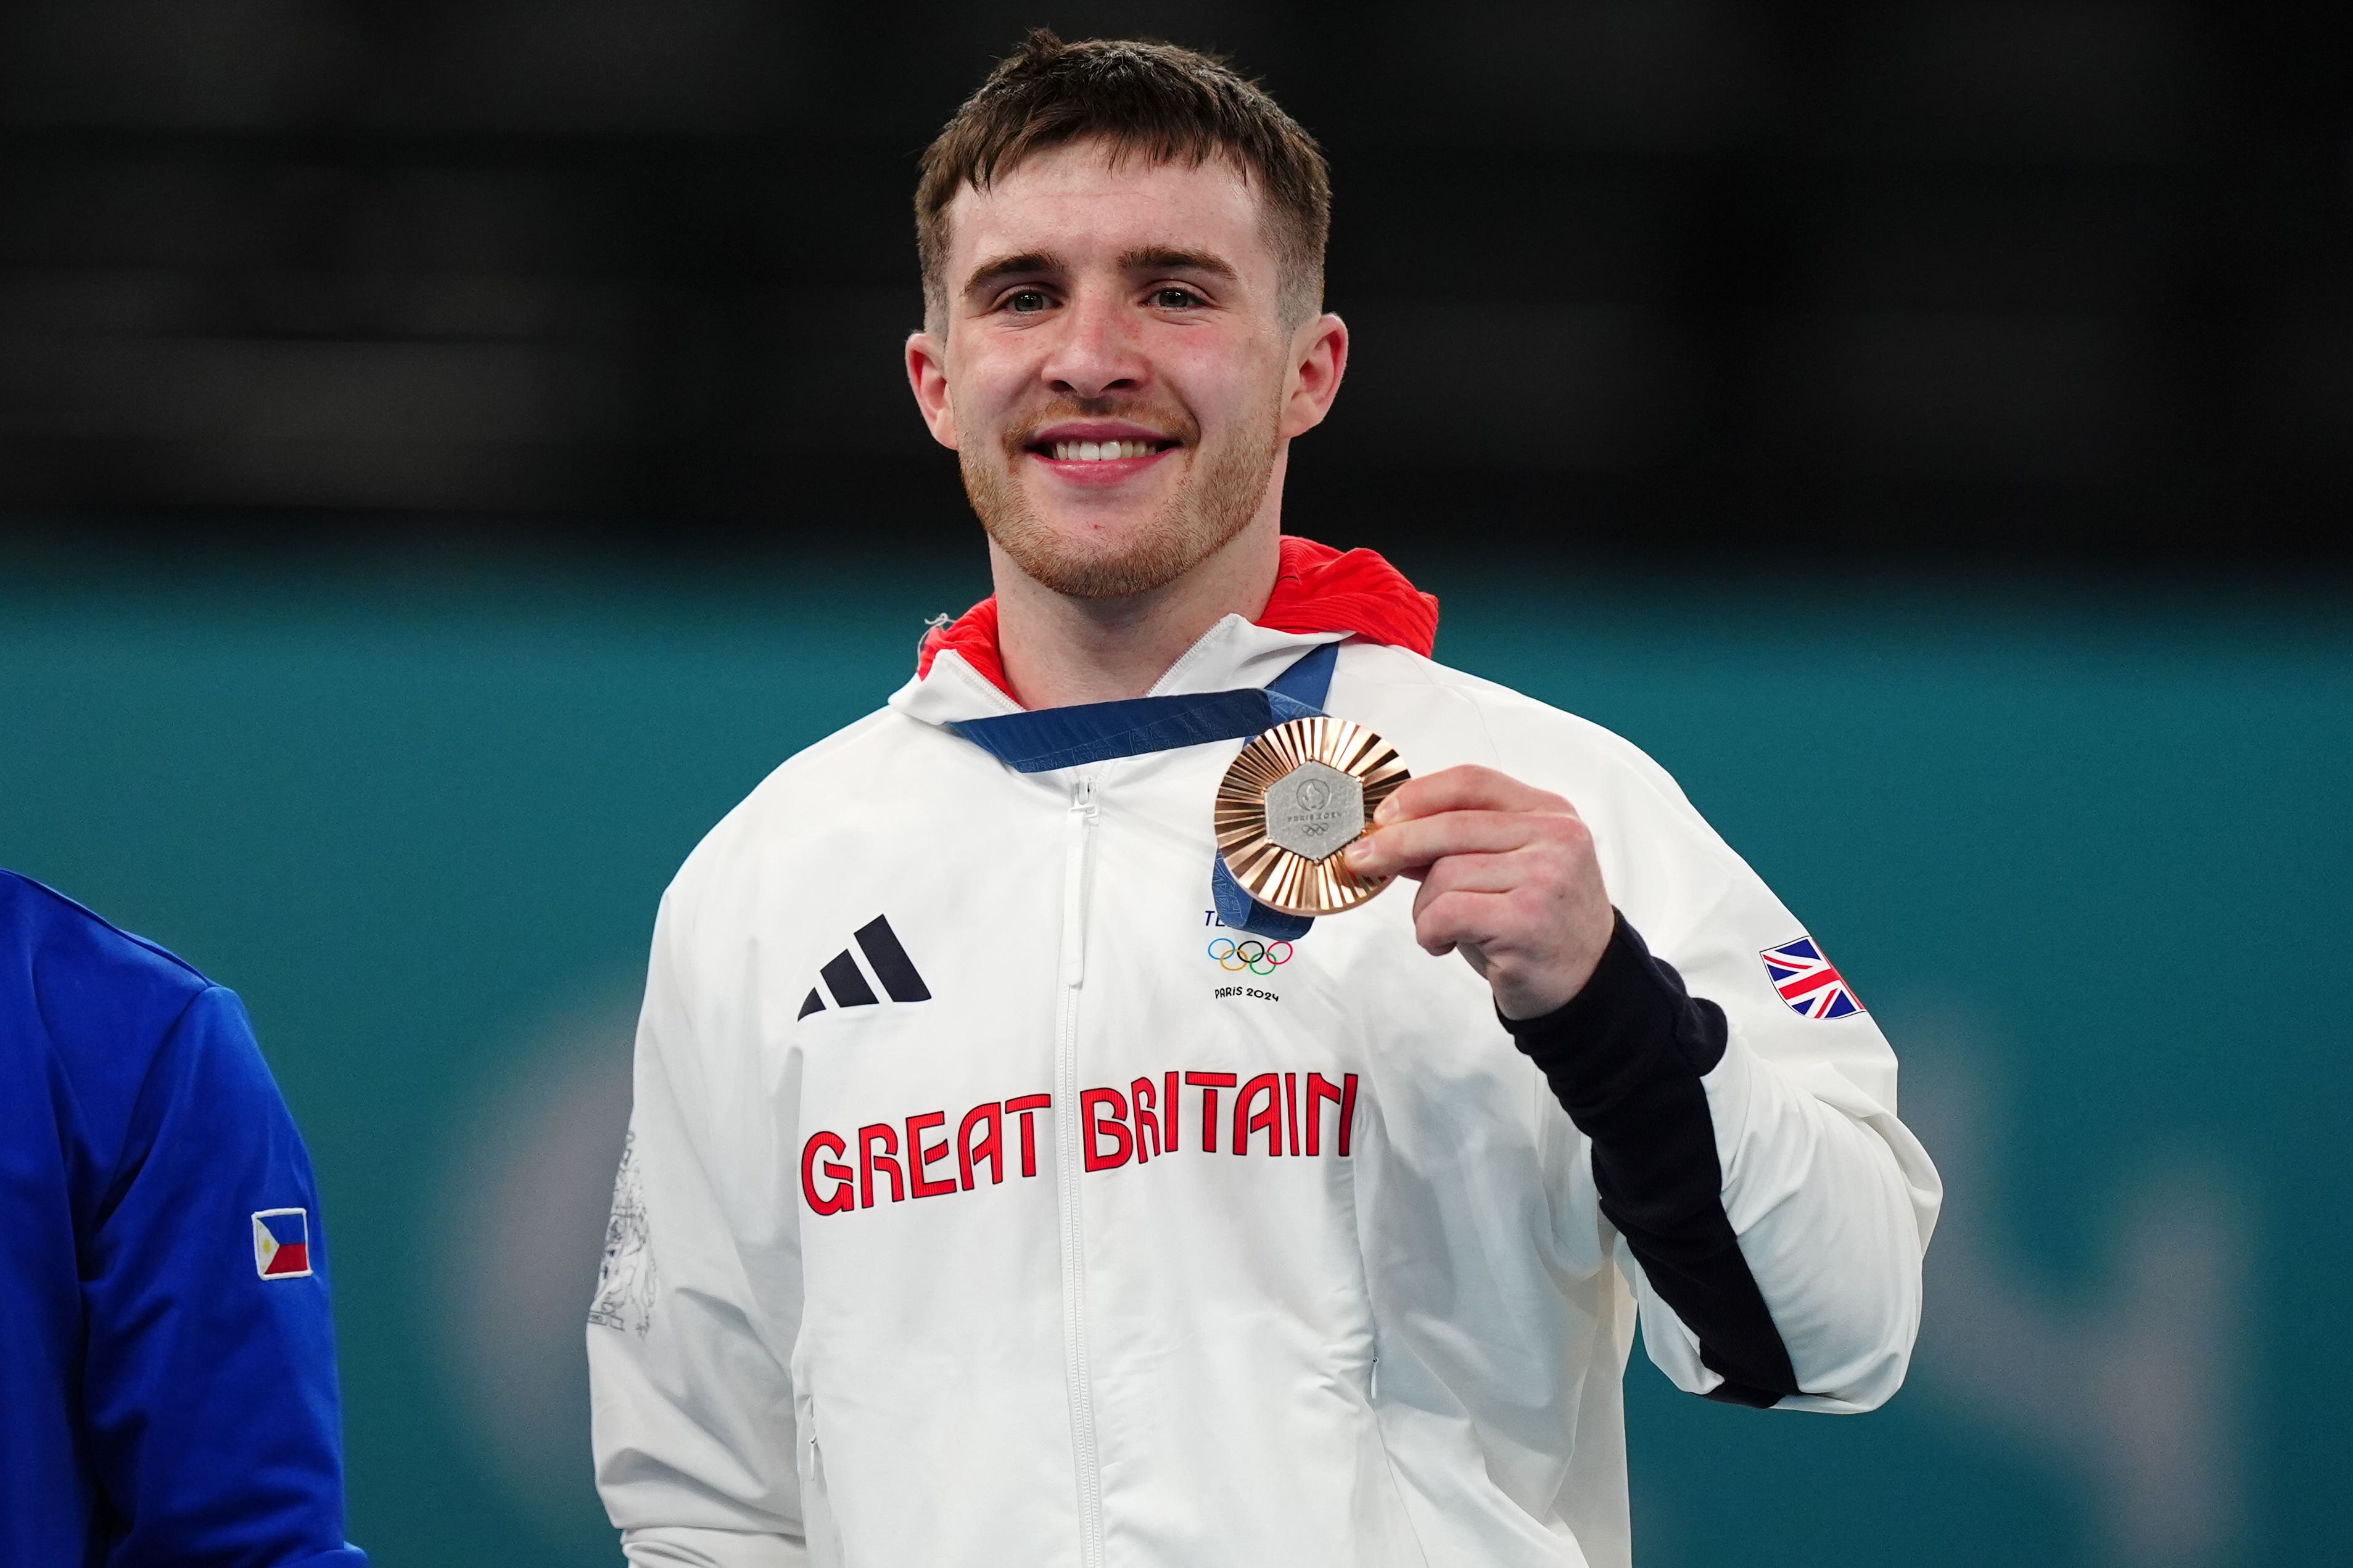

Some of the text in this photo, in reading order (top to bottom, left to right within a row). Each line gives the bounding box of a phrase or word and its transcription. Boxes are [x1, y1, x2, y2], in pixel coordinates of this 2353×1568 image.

[1214, 986, 1279, 1002] PARIS 2024
[801, 1070, 1359, 1217] GREAT BRITAIN
